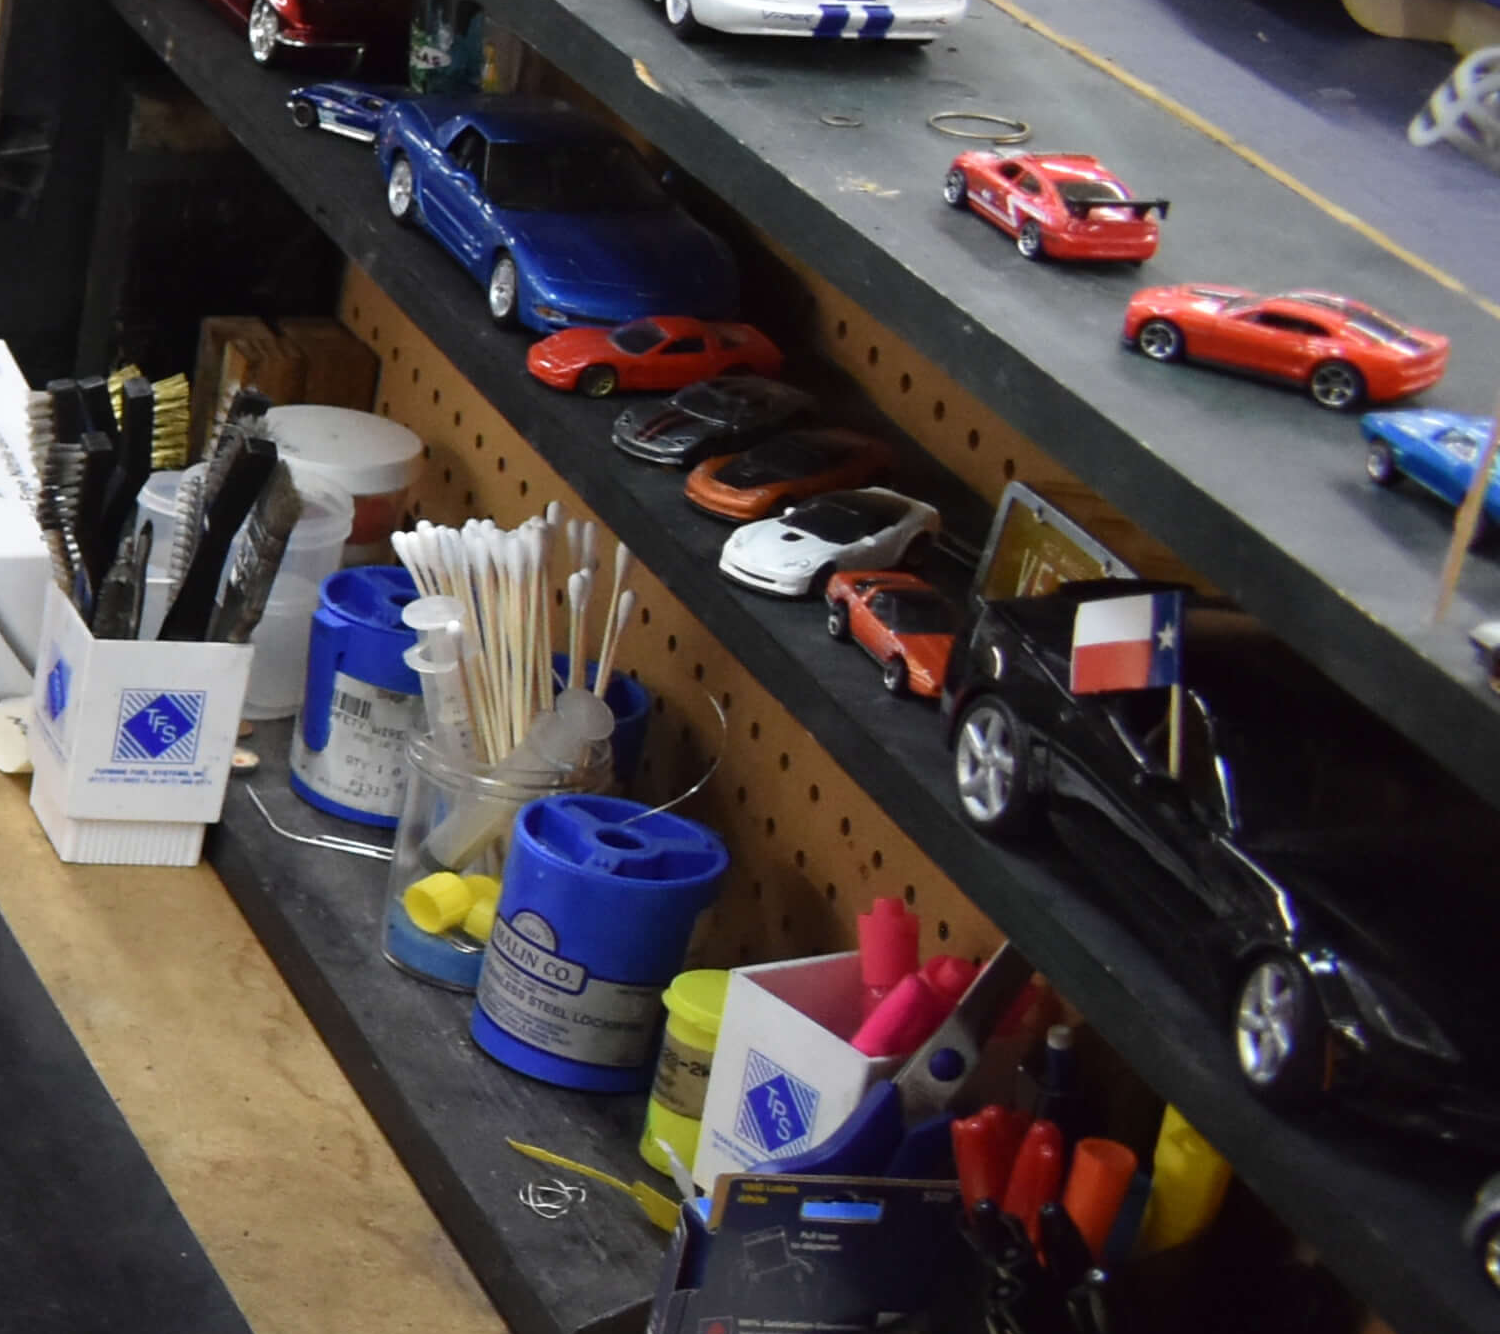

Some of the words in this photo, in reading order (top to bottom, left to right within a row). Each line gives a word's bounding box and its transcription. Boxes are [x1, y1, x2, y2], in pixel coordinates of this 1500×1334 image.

[145, 707, 177, 744] TFS
[496, 927, 541, 968] MALIN
[543, 960, 574, 985] CO.
[528, 995, 568, 1020] STEEL
[764, 1084, 793, 1141] TPS
